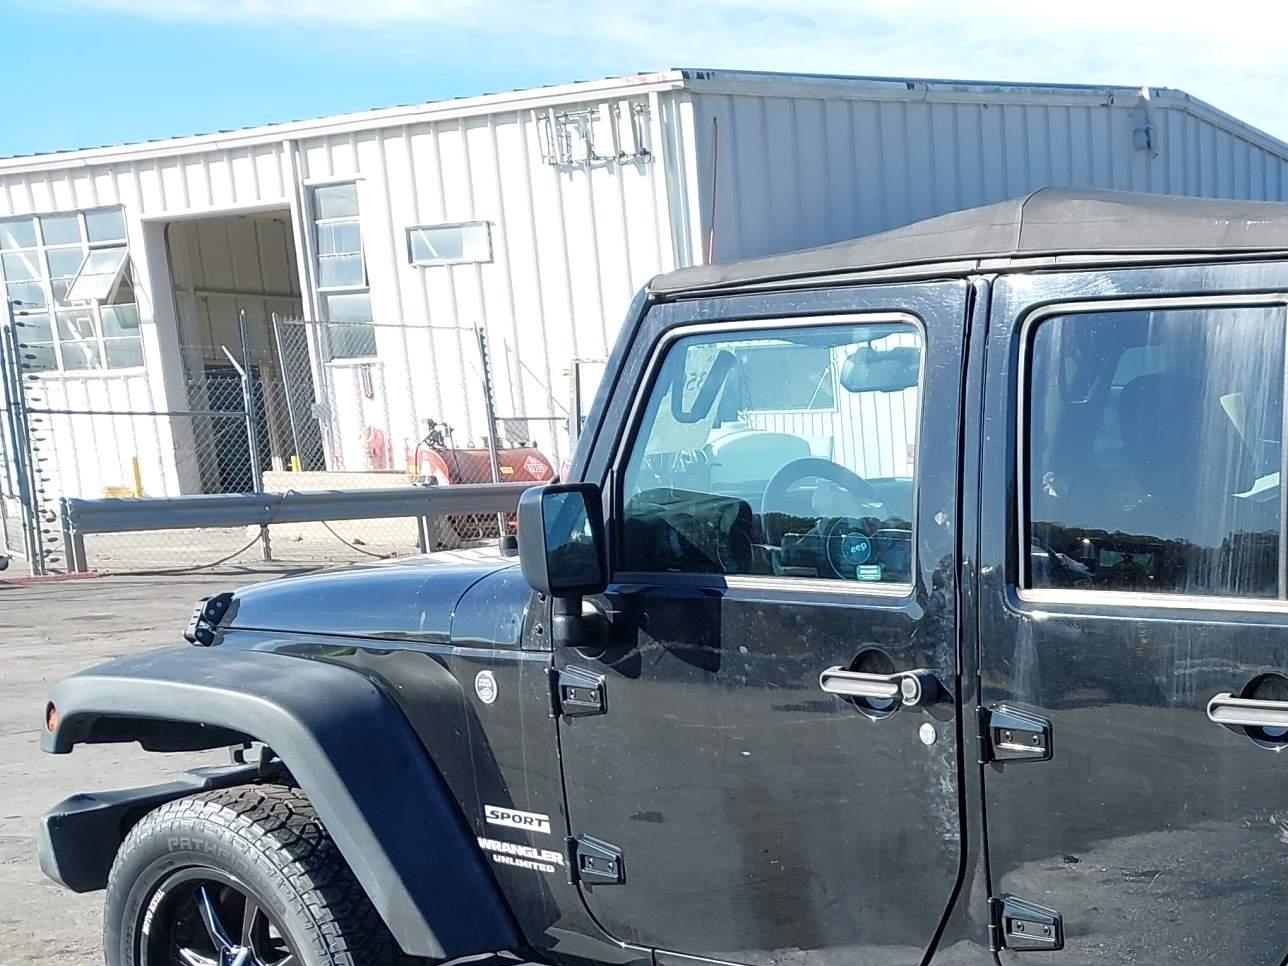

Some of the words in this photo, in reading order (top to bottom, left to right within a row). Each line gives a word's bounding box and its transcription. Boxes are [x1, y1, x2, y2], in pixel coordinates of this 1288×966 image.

[849, 542, 867, 553] eep
[486, 808, 549, 829] SPORT
[477, 837, 565, 866] WRANGLER
[493, 854, 555, 873] UNLIMITED
